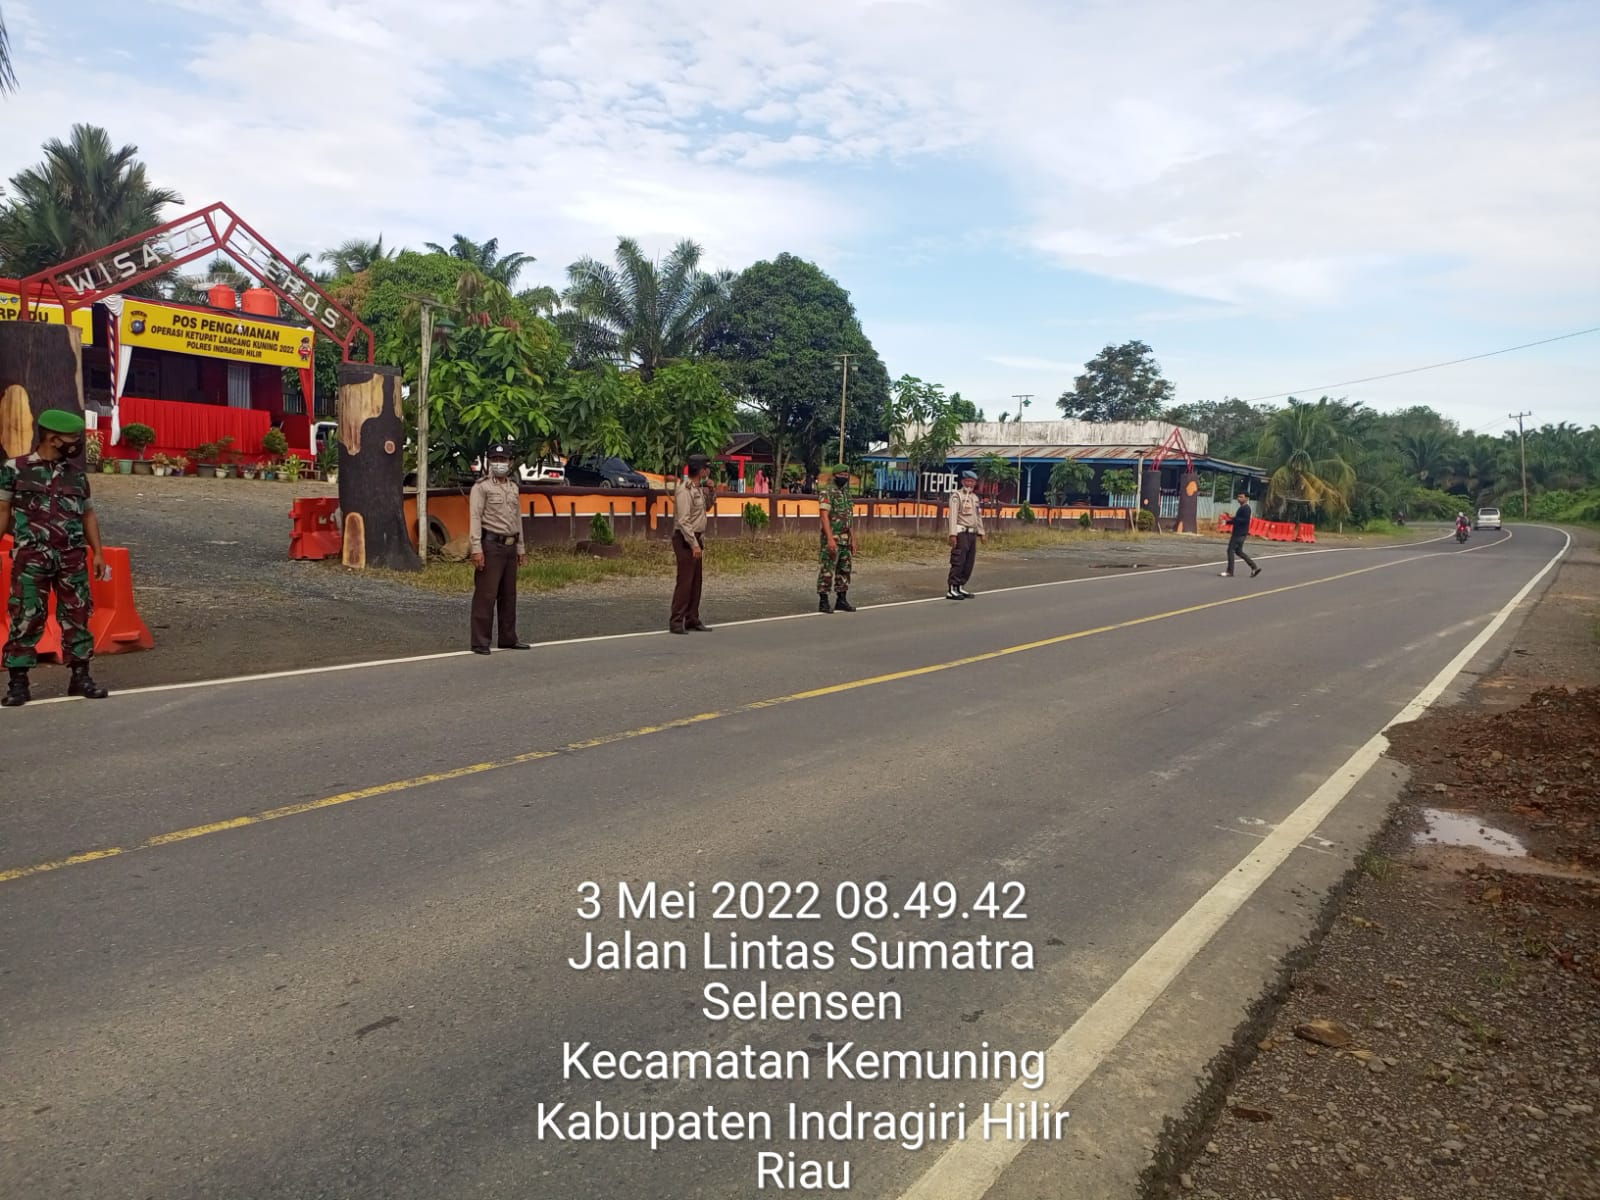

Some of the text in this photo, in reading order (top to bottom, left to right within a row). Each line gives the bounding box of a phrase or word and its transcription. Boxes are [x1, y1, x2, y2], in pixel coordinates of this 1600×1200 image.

[65, 227, 201, 295] WISATA
[150, 325, 295, 354] OPERASI KETUPAT LANCANG KUNING 2022
[172, 314, 281, 342] POS PENGAMANAN
[186, 340, 263, 359] POLRES INDRAGIRI HILIR
[922, 471, 959, 493] TEPOS
